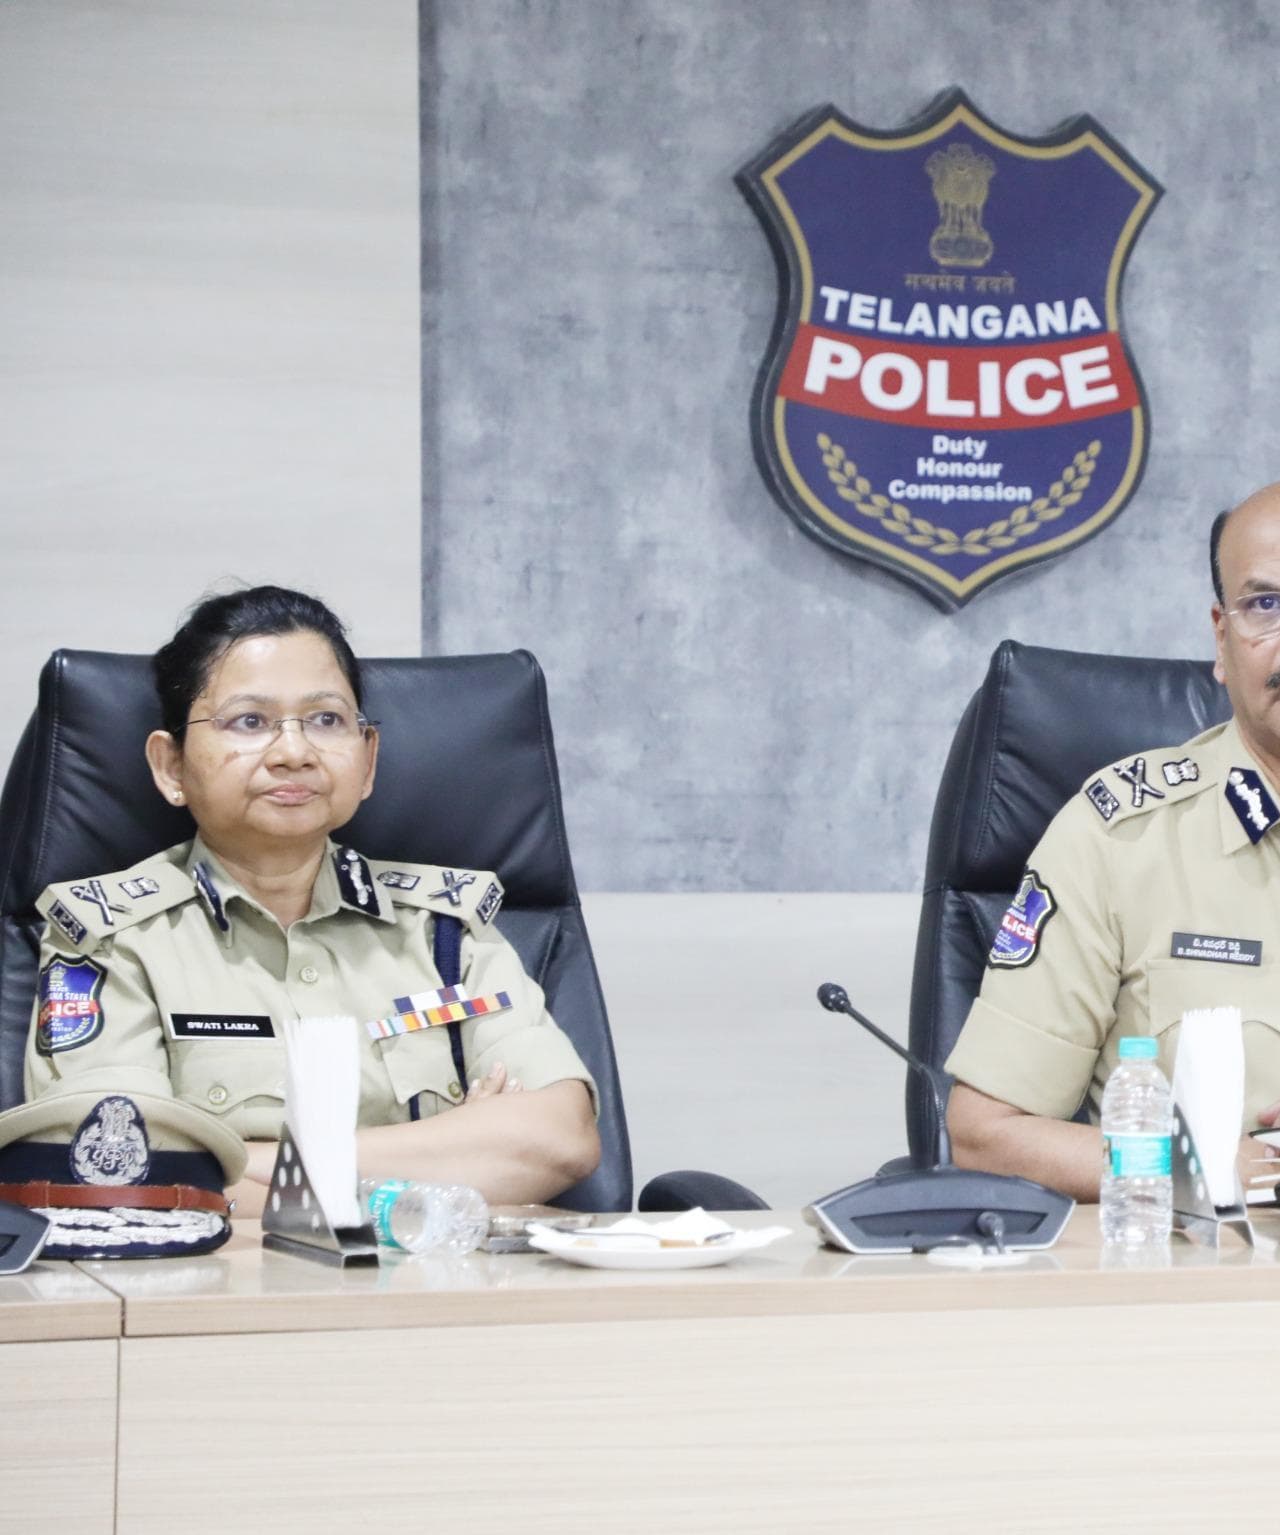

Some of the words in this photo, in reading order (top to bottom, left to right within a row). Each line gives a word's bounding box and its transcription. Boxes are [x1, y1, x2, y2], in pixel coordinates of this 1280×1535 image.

[820, 286, 1101, 340] TELANGANA
[803, 335, 1120, 418] POLICE
[932, 435, 988, 459] Duty
[916, 457, 1003, 480] Honour
[888, 479, 1033, 503] Compassion
[1229, 952, 1256, 962] REDDY
[187, 1021, 221, 1030] SWATI
[223, 1022, 260, 1031] LAKRA
